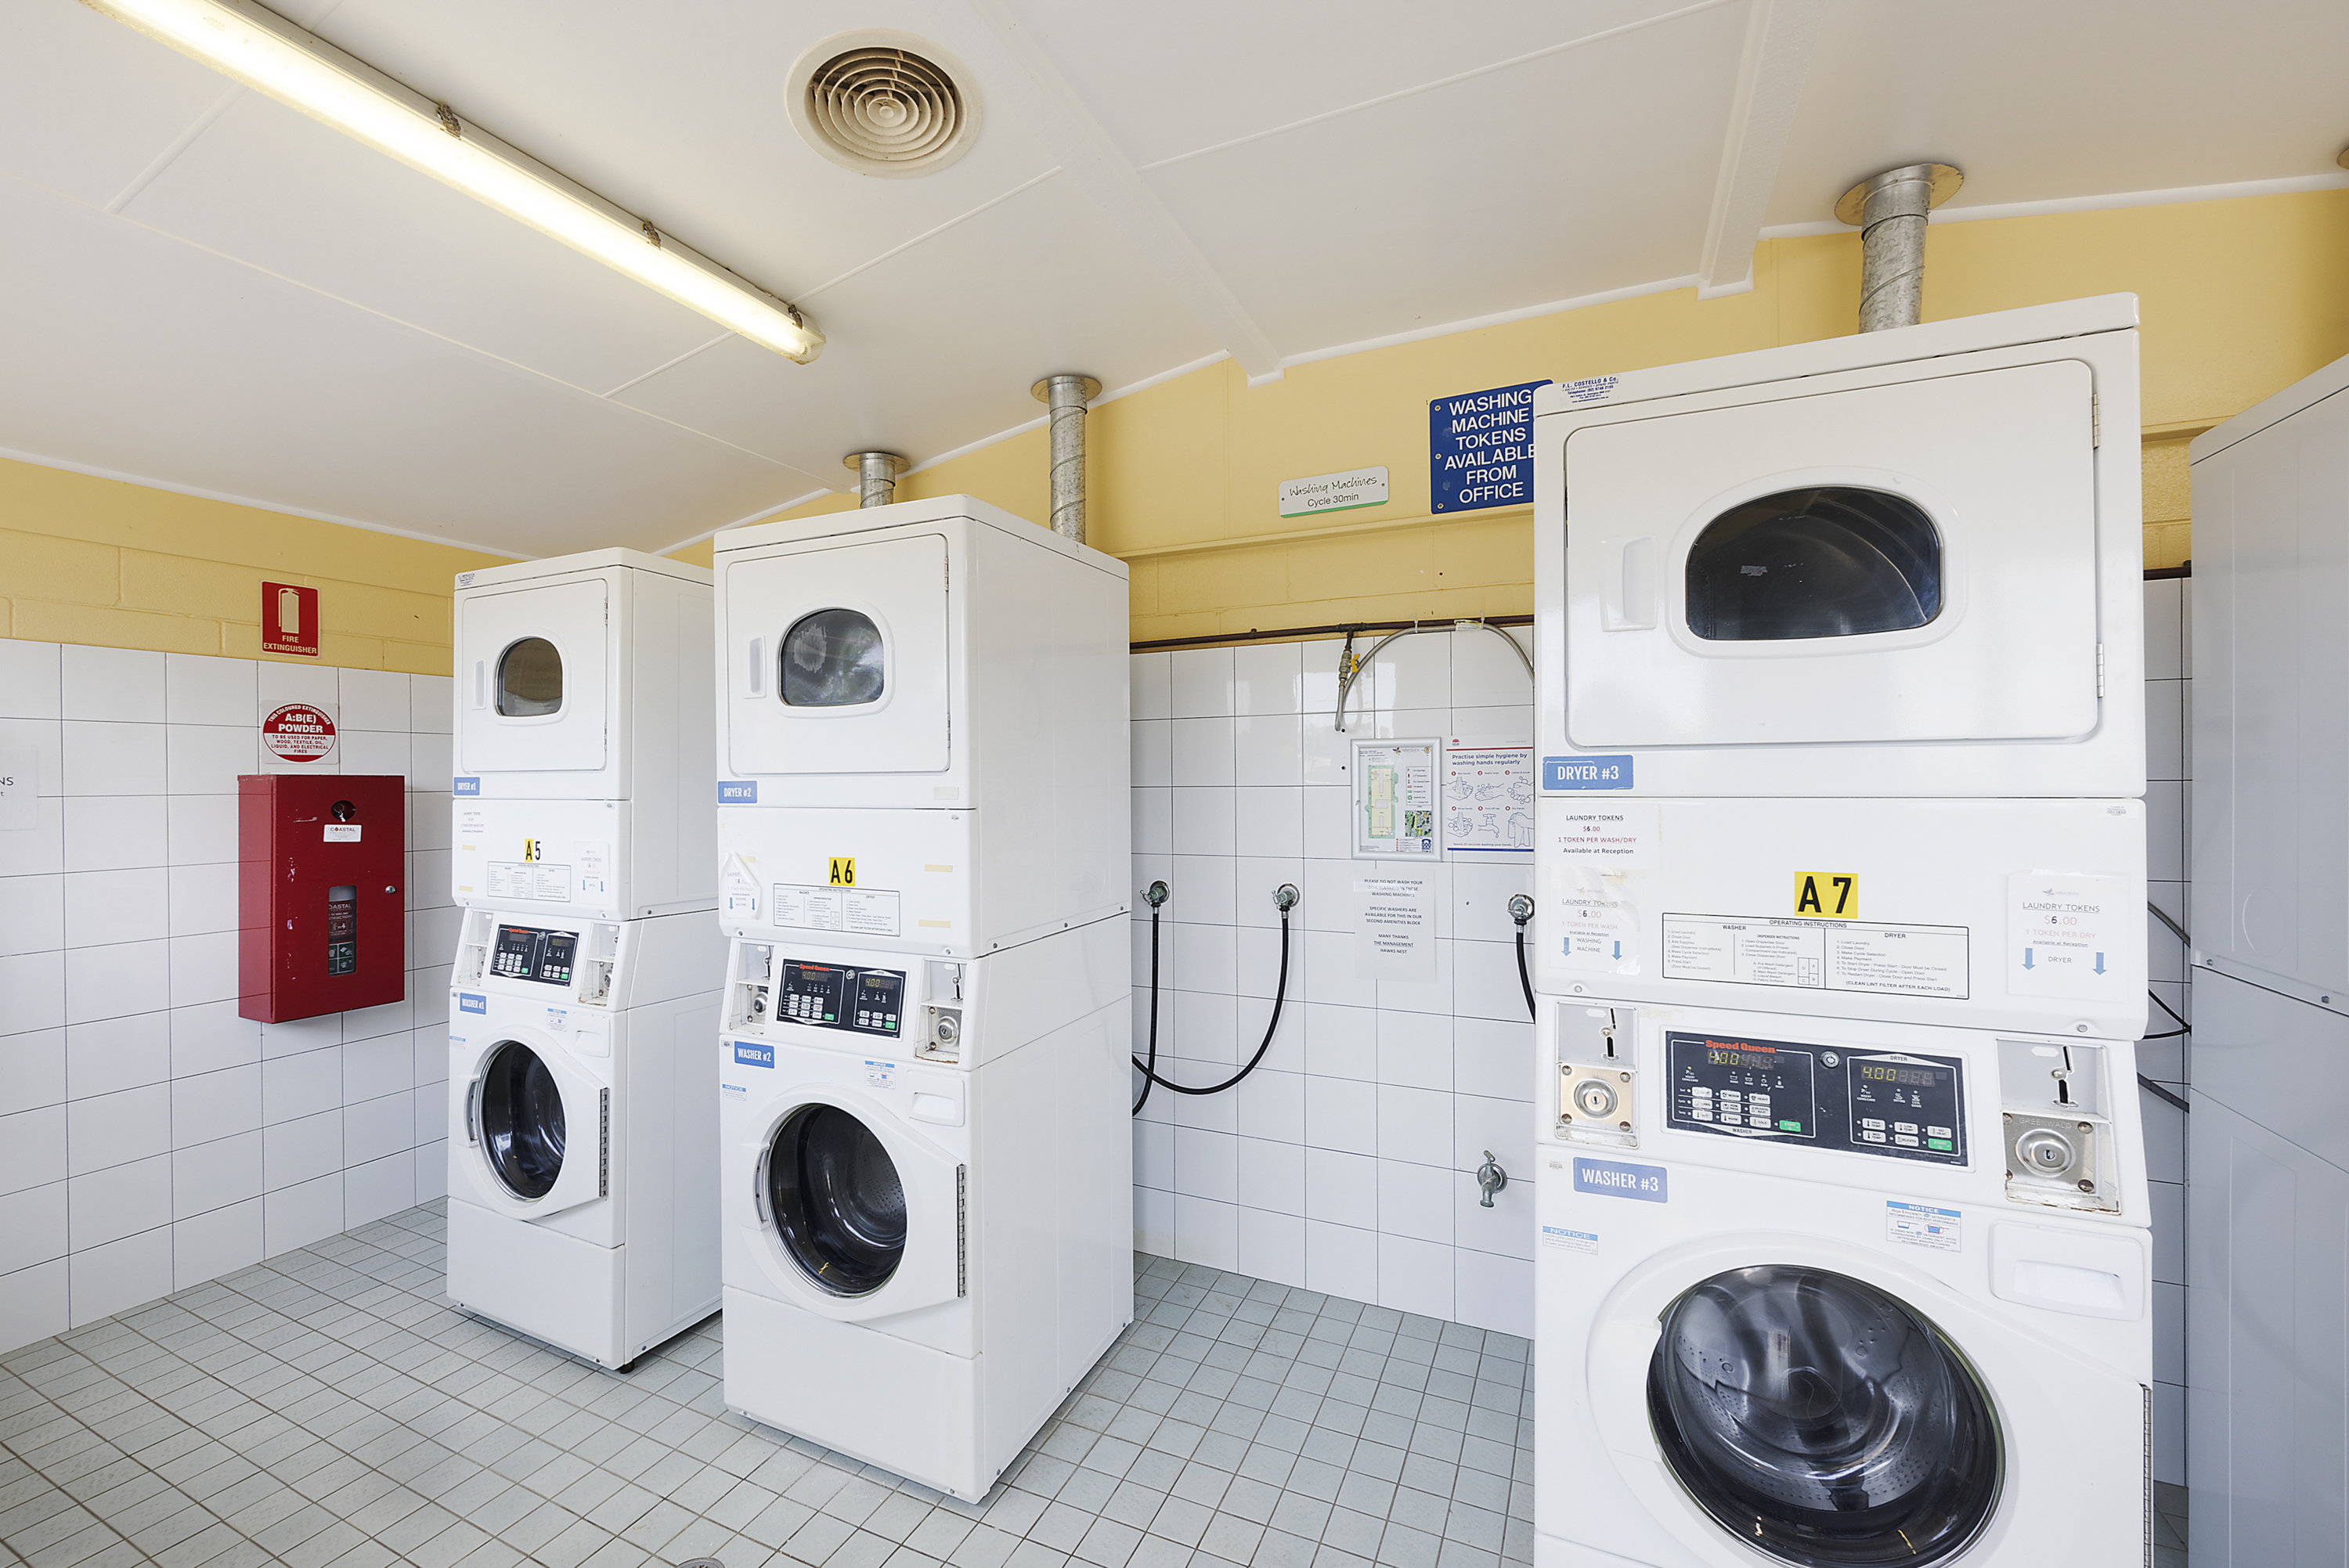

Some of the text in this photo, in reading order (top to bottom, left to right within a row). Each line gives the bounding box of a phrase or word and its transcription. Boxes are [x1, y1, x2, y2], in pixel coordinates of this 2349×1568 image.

[1574, 378, 1601, 387] COSTELLO
[1449, 389, 1532, 416] WASHING
[1452, 408, 1529, 434] MACHINE
[1456, 427, 1526, 450] TOKENS
[1467, 464, 1517, 485] FROM
[1290, 476, 1377, 496] Washing Machines
[1459, 481, 1524, 503] OFFICE
[1308, 492, 1359, 508] Cycle 30min
[263, 642, 317, 654] EXTINGUISHER
[285, 713, 316, 724] A:B(E)
[278, 723, 323, 733] POWDER
[1557, 765, 1619, 780] DRYER #3
[723, 788, 752, 797] DRYER #2
[2022, 902, 2100, 913] LAUNDRY TOKENS
[462, 998, 478, 1008] WASHER
[1705, 1040, 1777, 1054] Speed Queen
[738, 1047, 771, 1062] WASHER #2
[1582, 1168, 1659, 1191] WASHER #3
[1909, 1205, 1939, 1213] NOTICE
[1550, 1228, 1591, 1239] NOTICE
